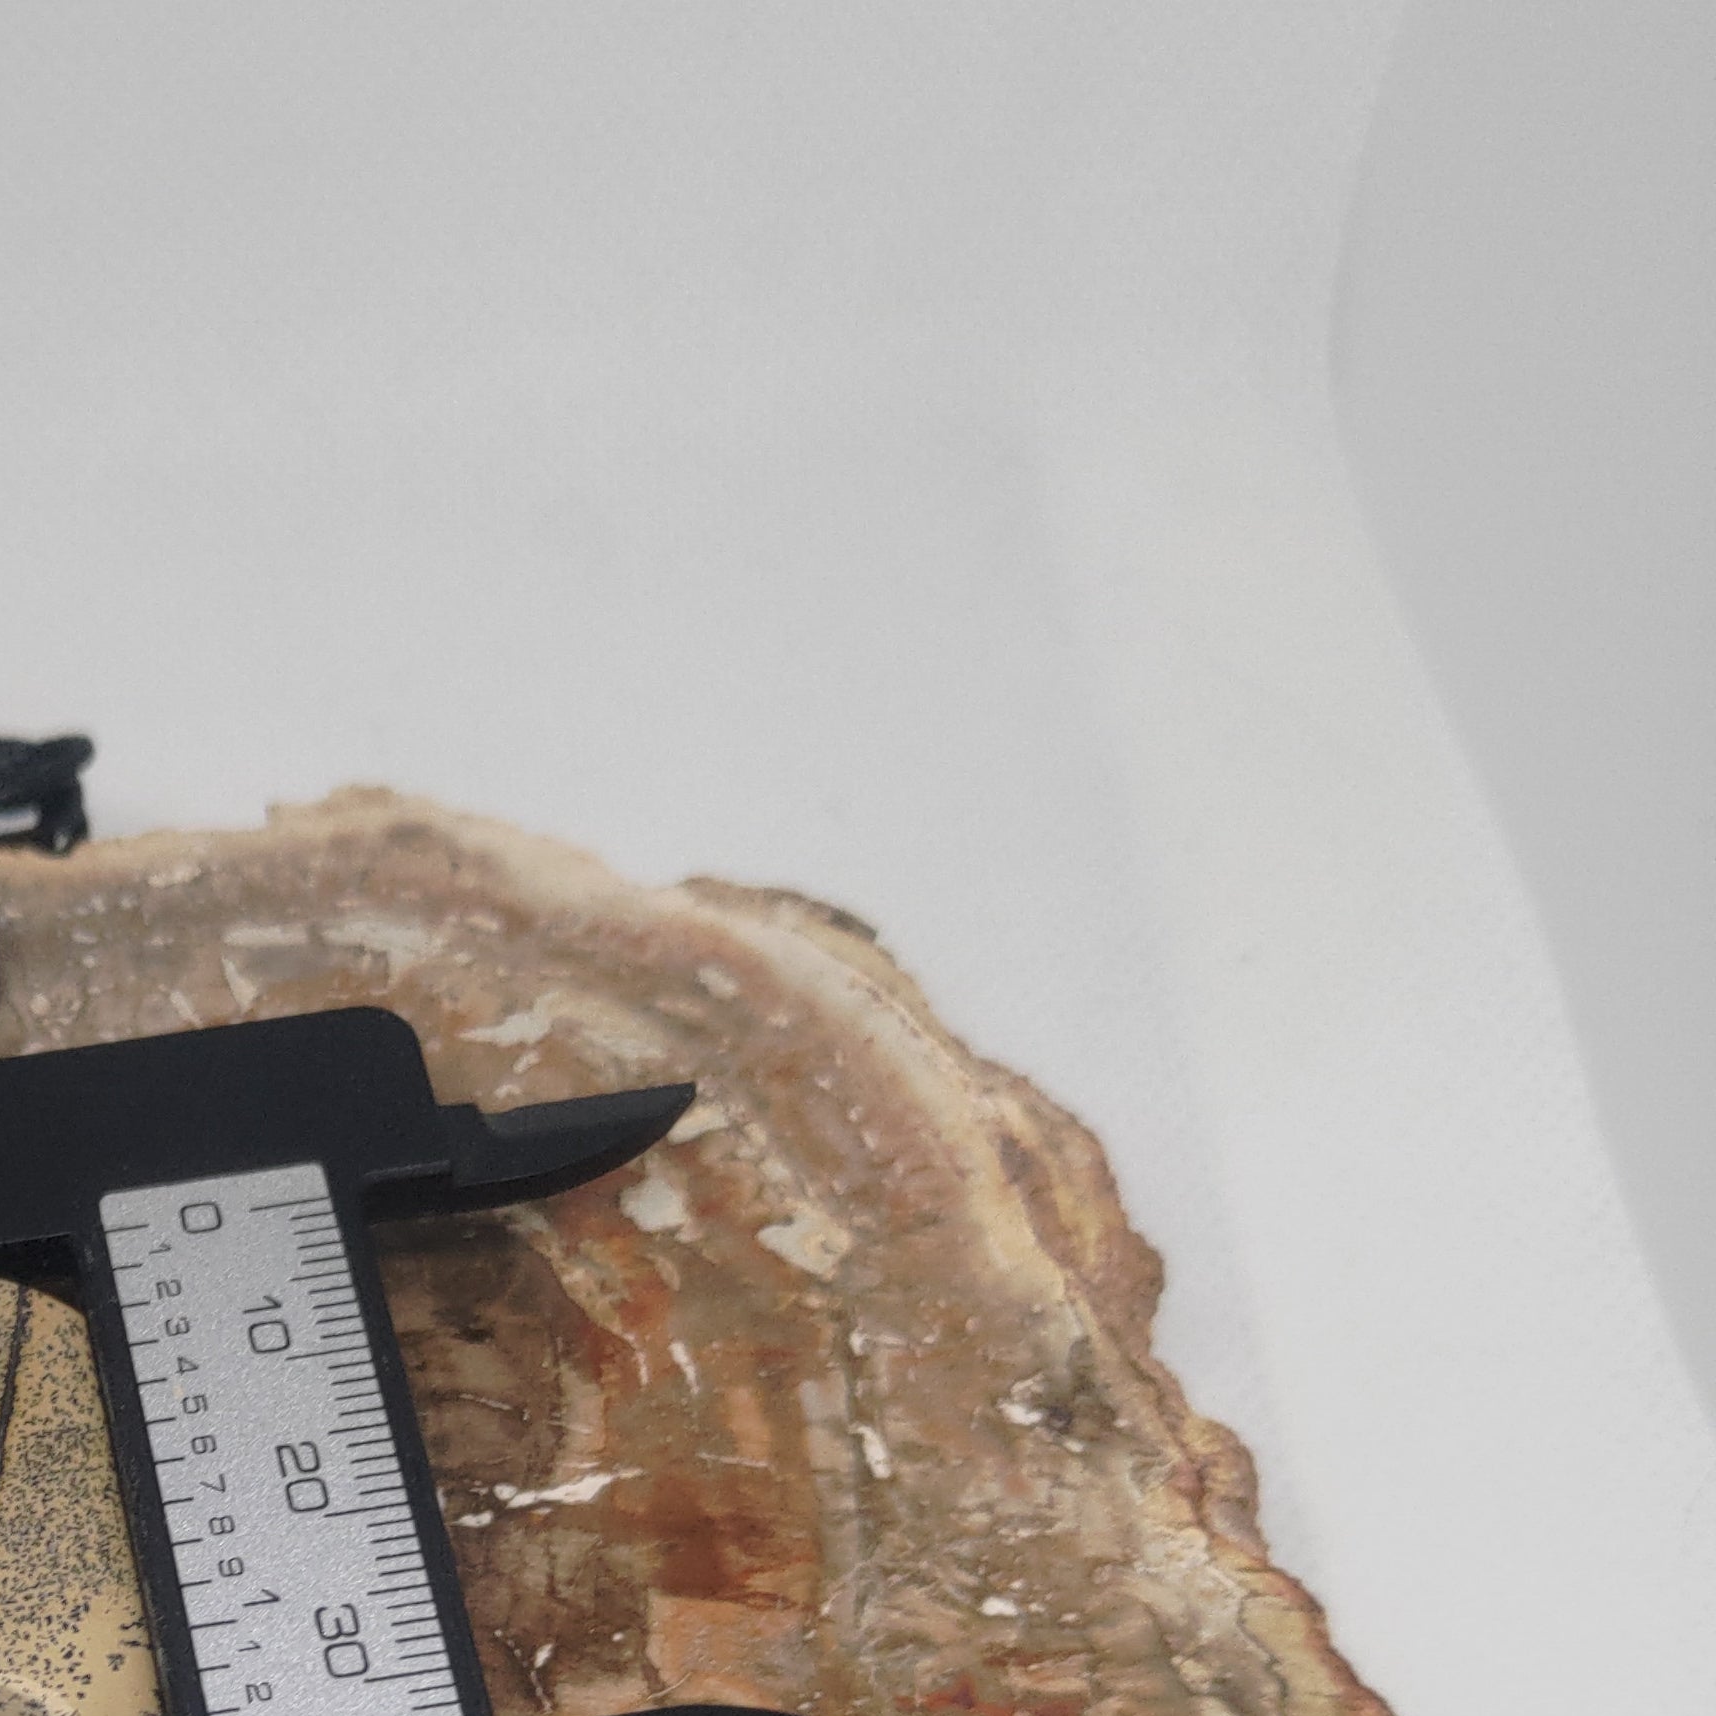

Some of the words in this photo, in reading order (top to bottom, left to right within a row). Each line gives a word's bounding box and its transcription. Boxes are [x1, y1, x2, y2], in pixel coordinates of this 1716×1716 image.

[148, 1241, 172, 1255] 1
[156, 1279, 182, 1298] 2
[164, 1317, 190, 1337] 3
[175, 1356, 199, 1375] 4
[182, 1394, 208, 1415] 5
[179, 1202, 222, 1234] 0
[241, 1295, 290, 1354] 10
[275, 1441, 329, 1513] 20
[314, 1603, 369, 1679] 30
[191, 1434, 217, 1455] 6
[200, 1473, 226, 1493] 7
[208, 1514, 236, 1536] 8
[218, 1556, 244, 1578] 9
[242, 1589, 282, 1607] 1
[237, 1639, 262, 1653] 1
[246, 1682, 273, 1704] 2
